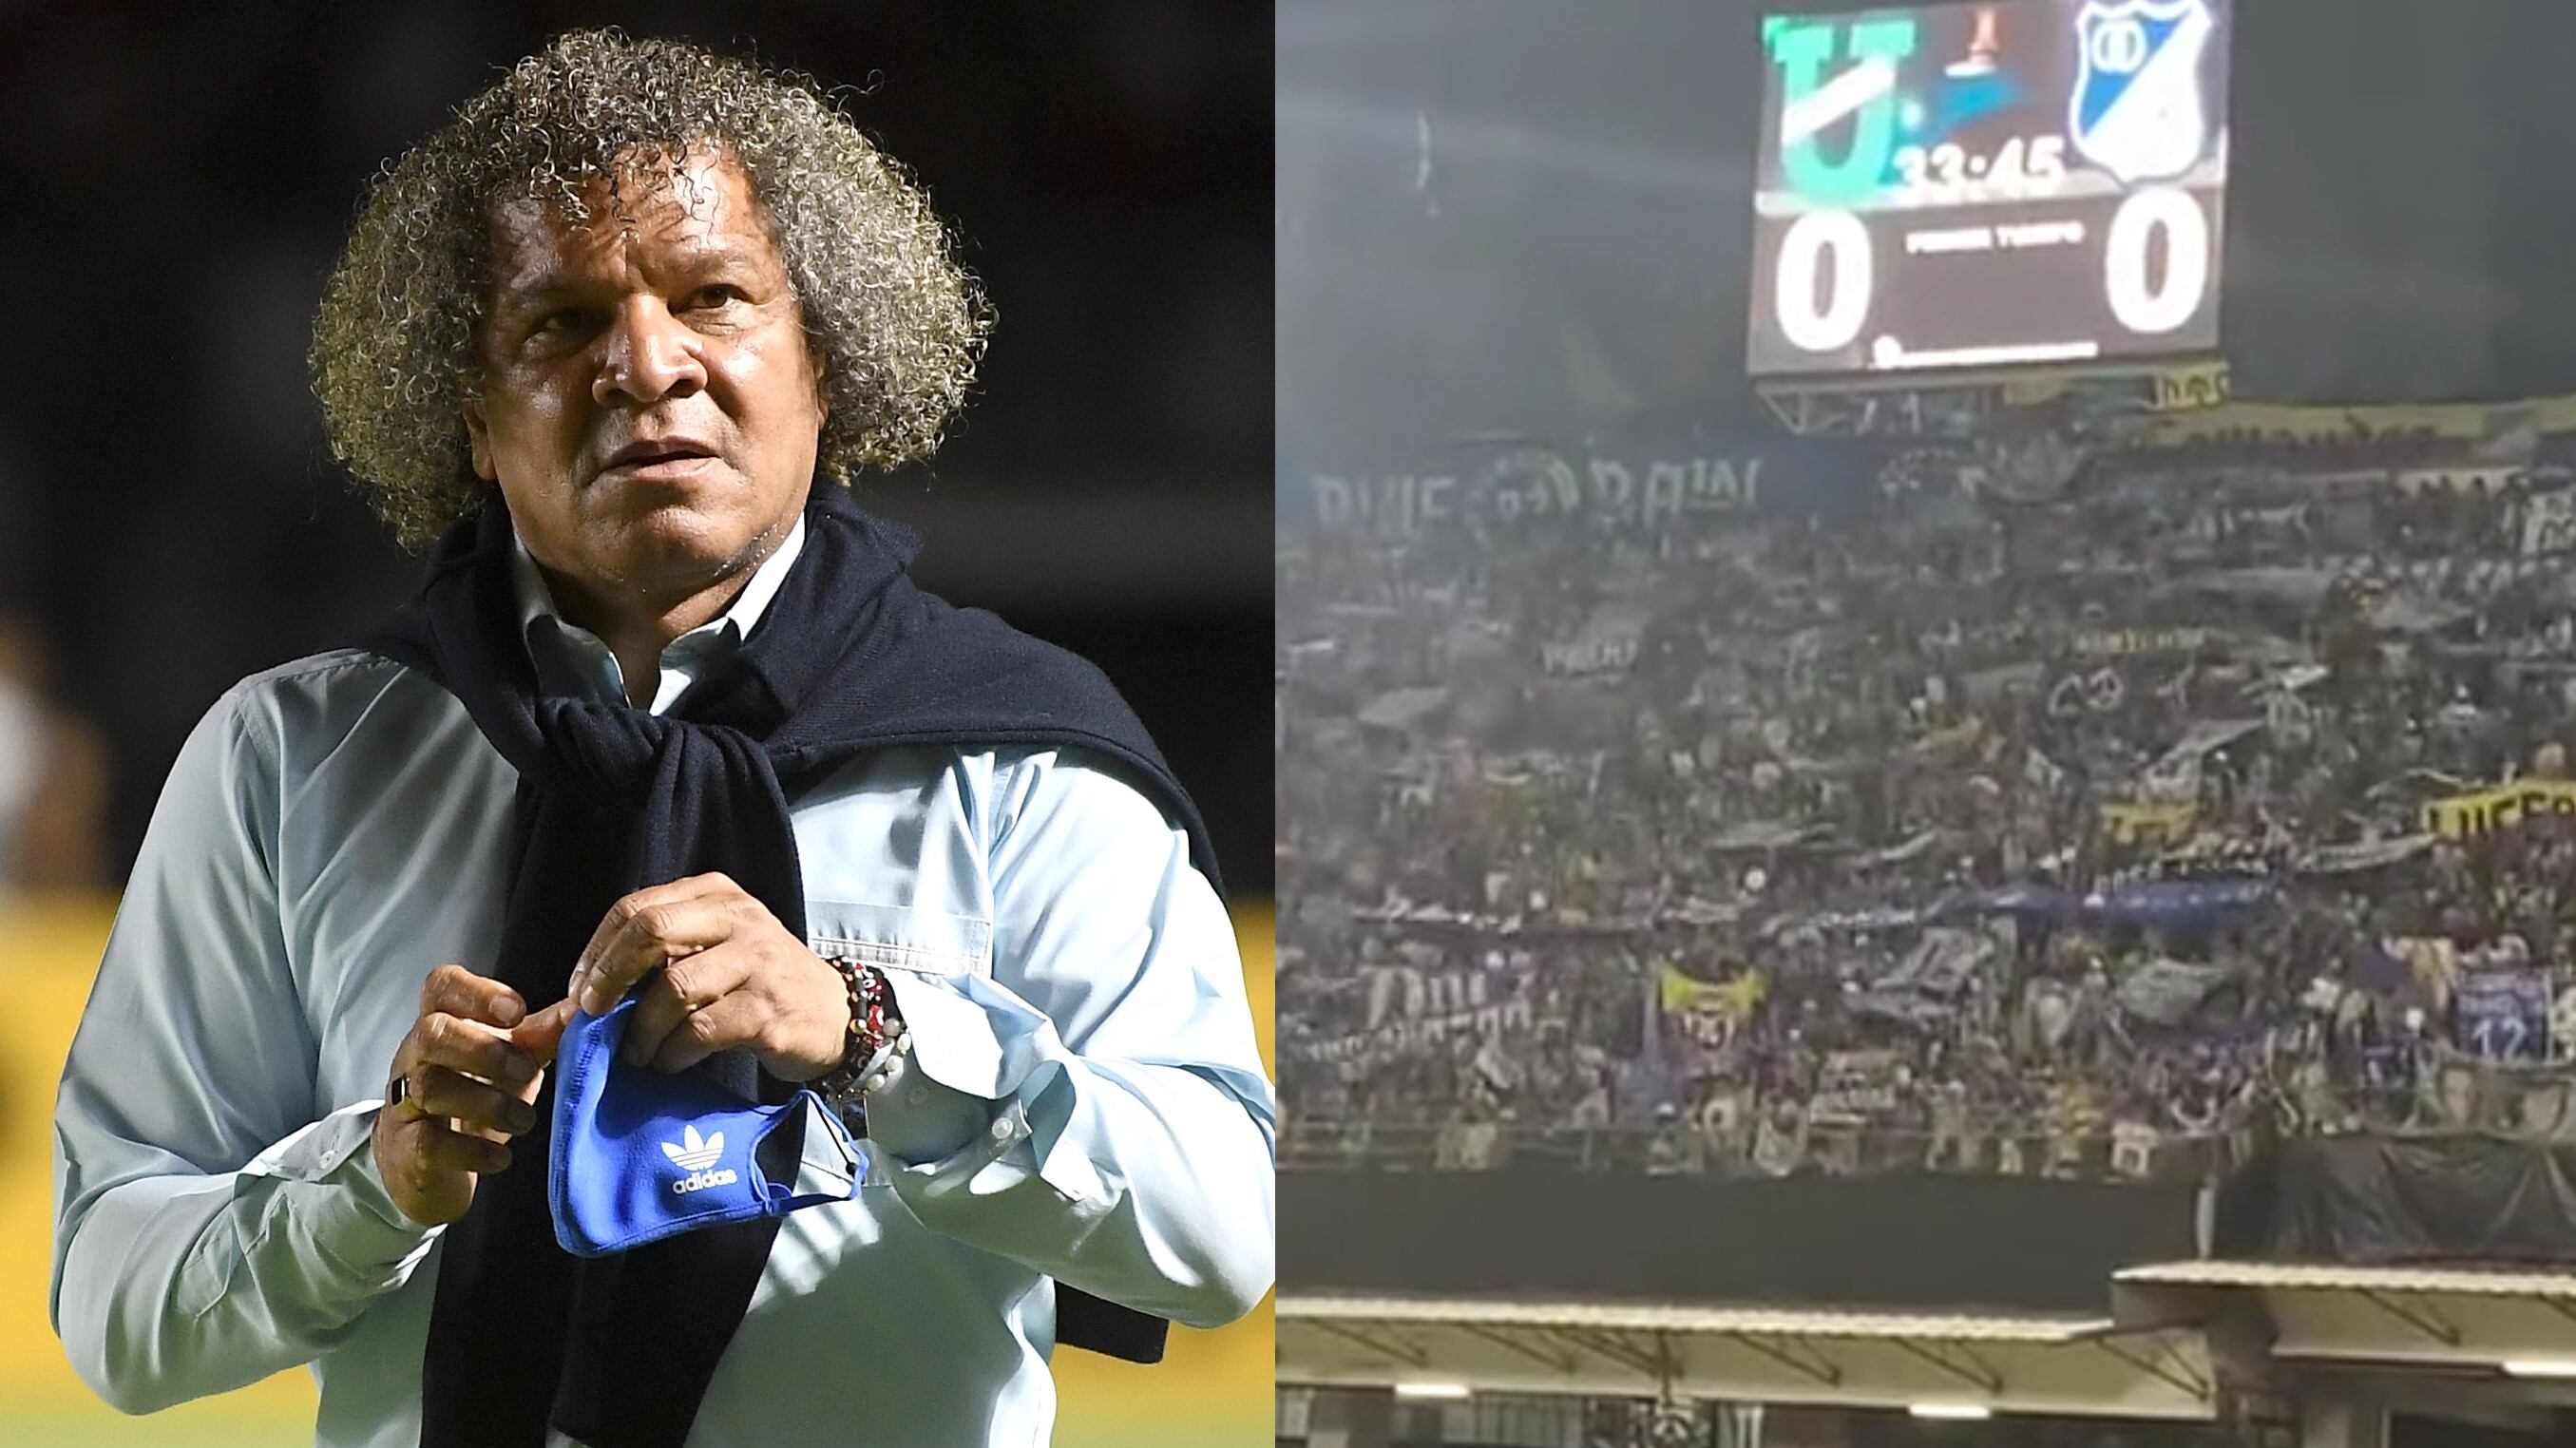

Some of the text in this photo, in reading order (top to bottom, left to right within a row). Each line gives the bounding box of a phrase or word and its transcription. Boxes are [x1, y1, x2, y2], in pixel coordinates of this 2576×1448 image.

[1892, 134, 2068, 203] 33:45
[1775, 209, 1872, 352] 0
[2106, 188, 2208, 333] 0
[672, 1169, 737, 1194] adidas
